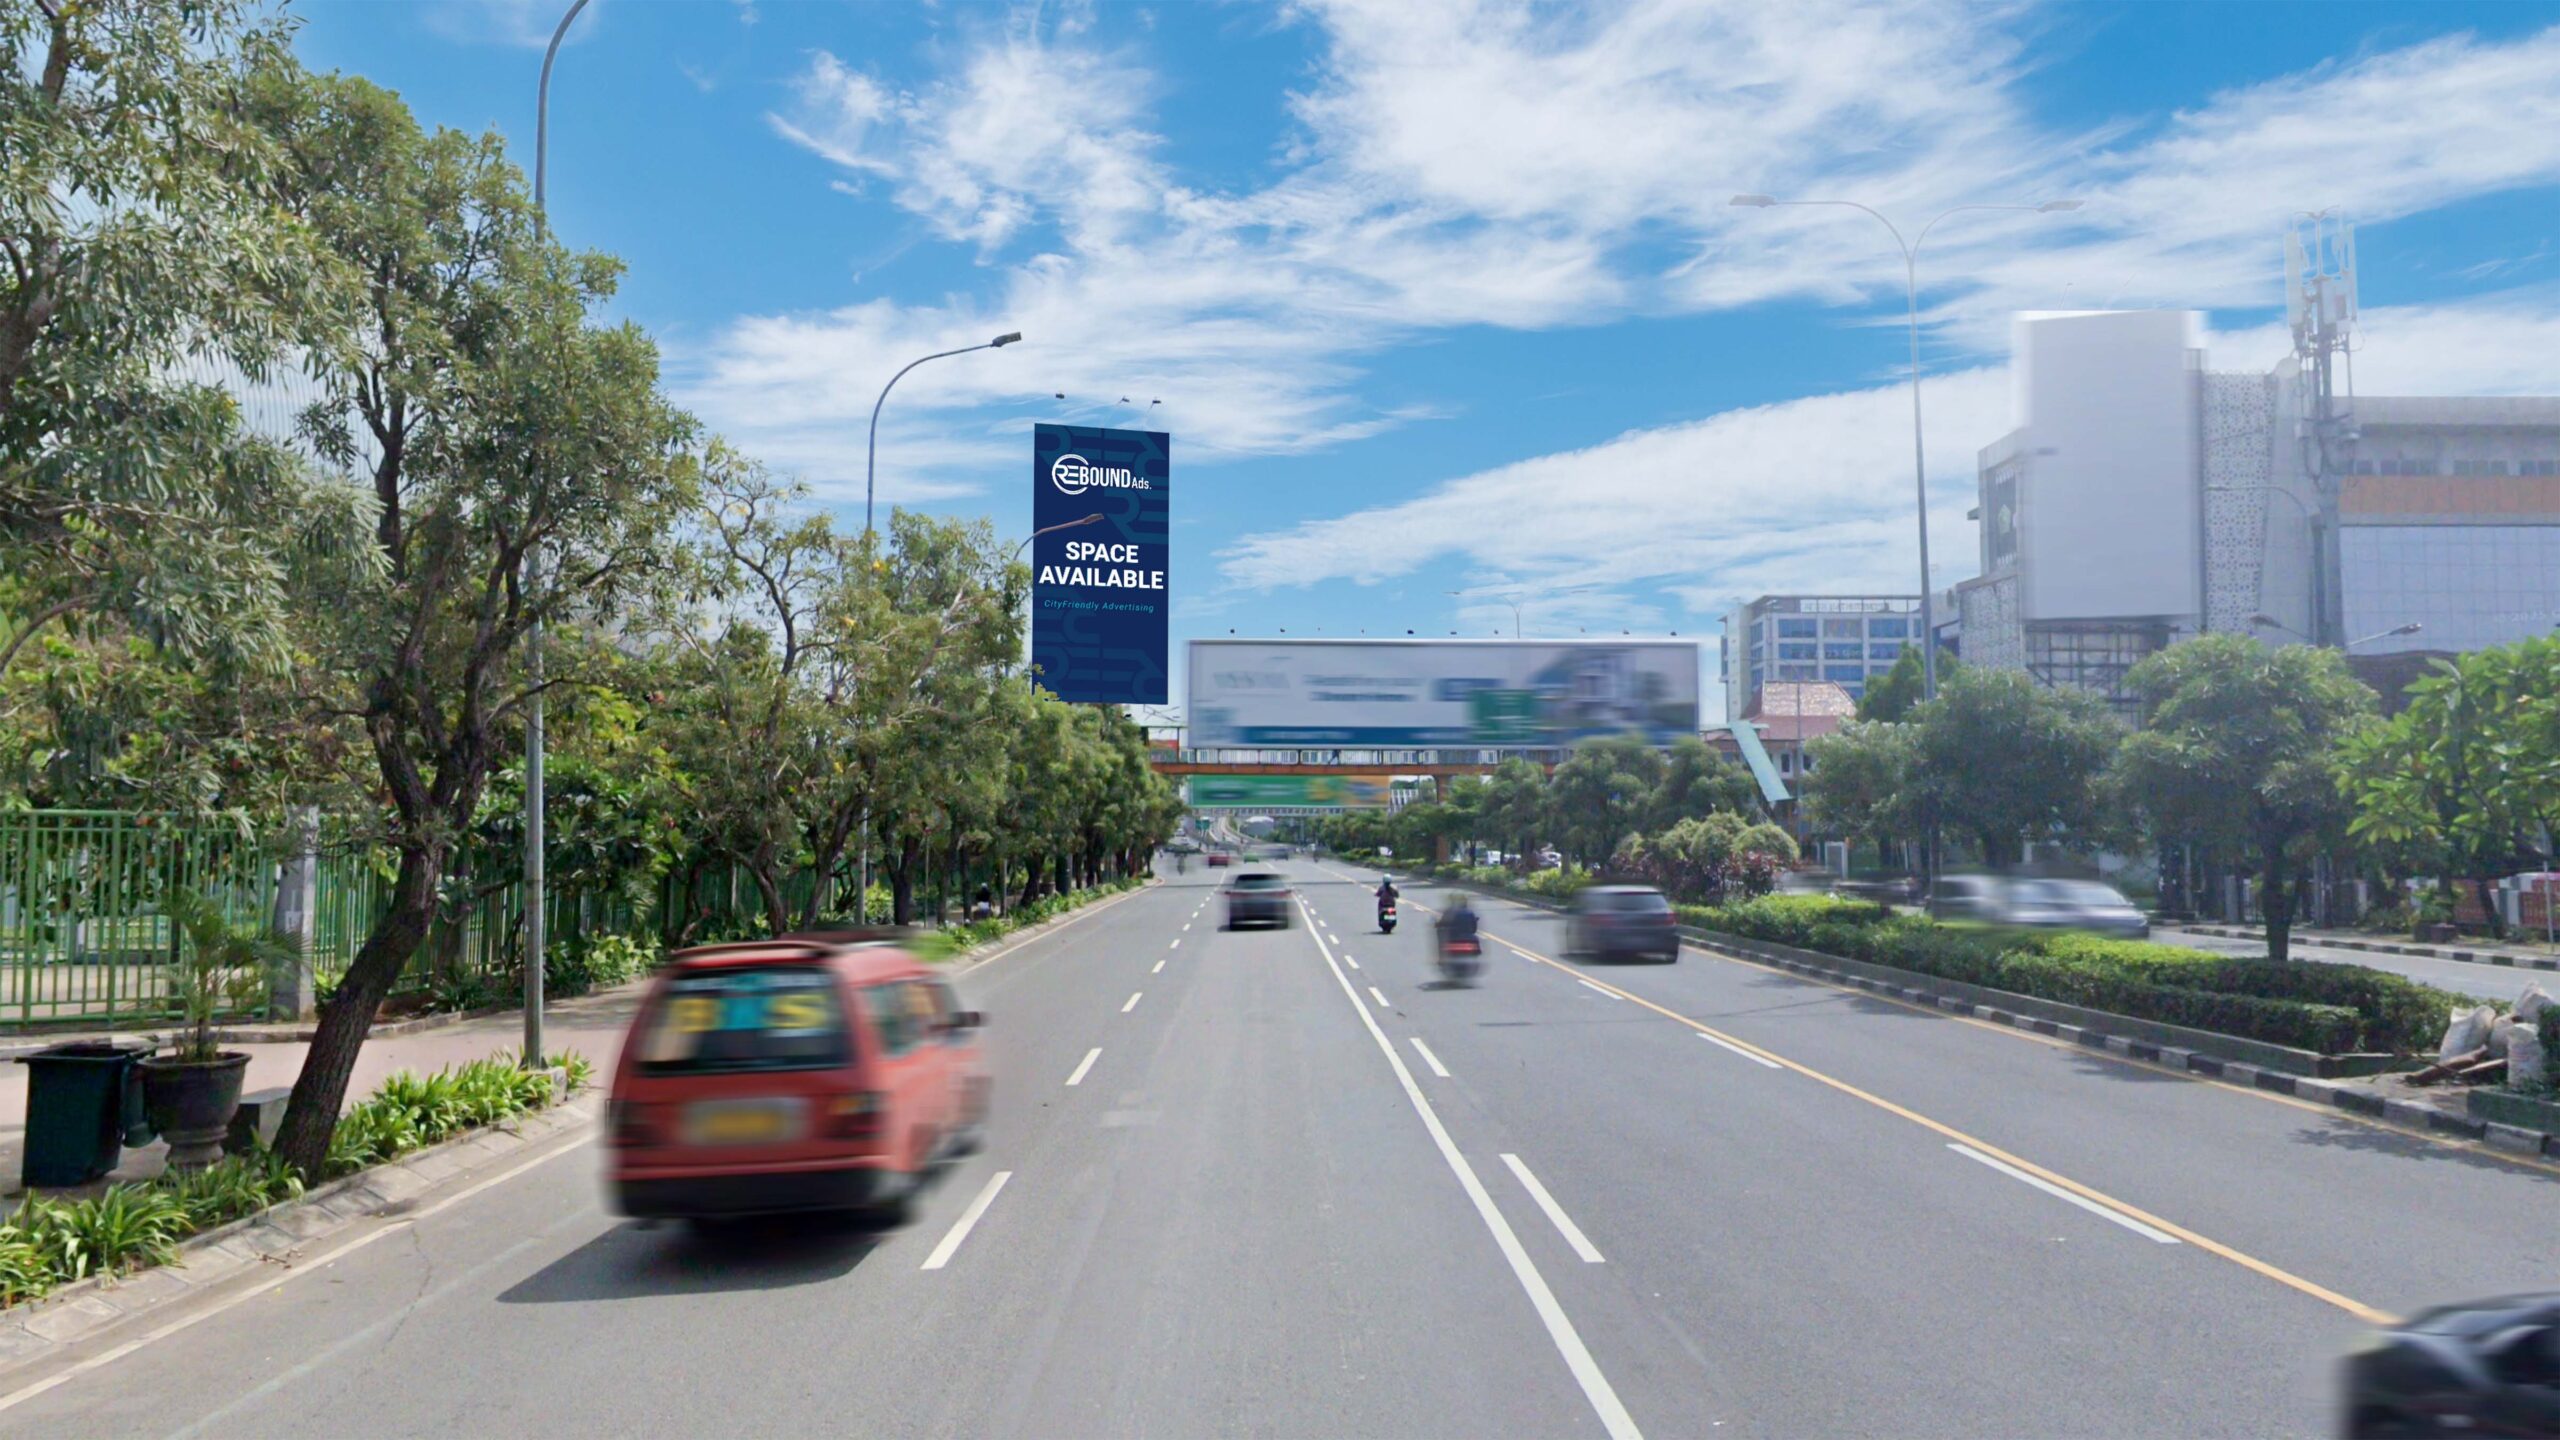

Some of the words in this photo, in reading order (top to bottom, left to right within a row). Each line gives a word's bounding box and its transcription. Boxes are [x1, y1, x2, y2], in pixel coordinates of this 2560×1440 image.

[1066, 541, 1139, 564] SPACE
[1038, 566, 1164, 590] AVAILABLE
[1044, 599, 1099, 611] CityFriendly
[1102, 602, 1154, 613] Advertising
